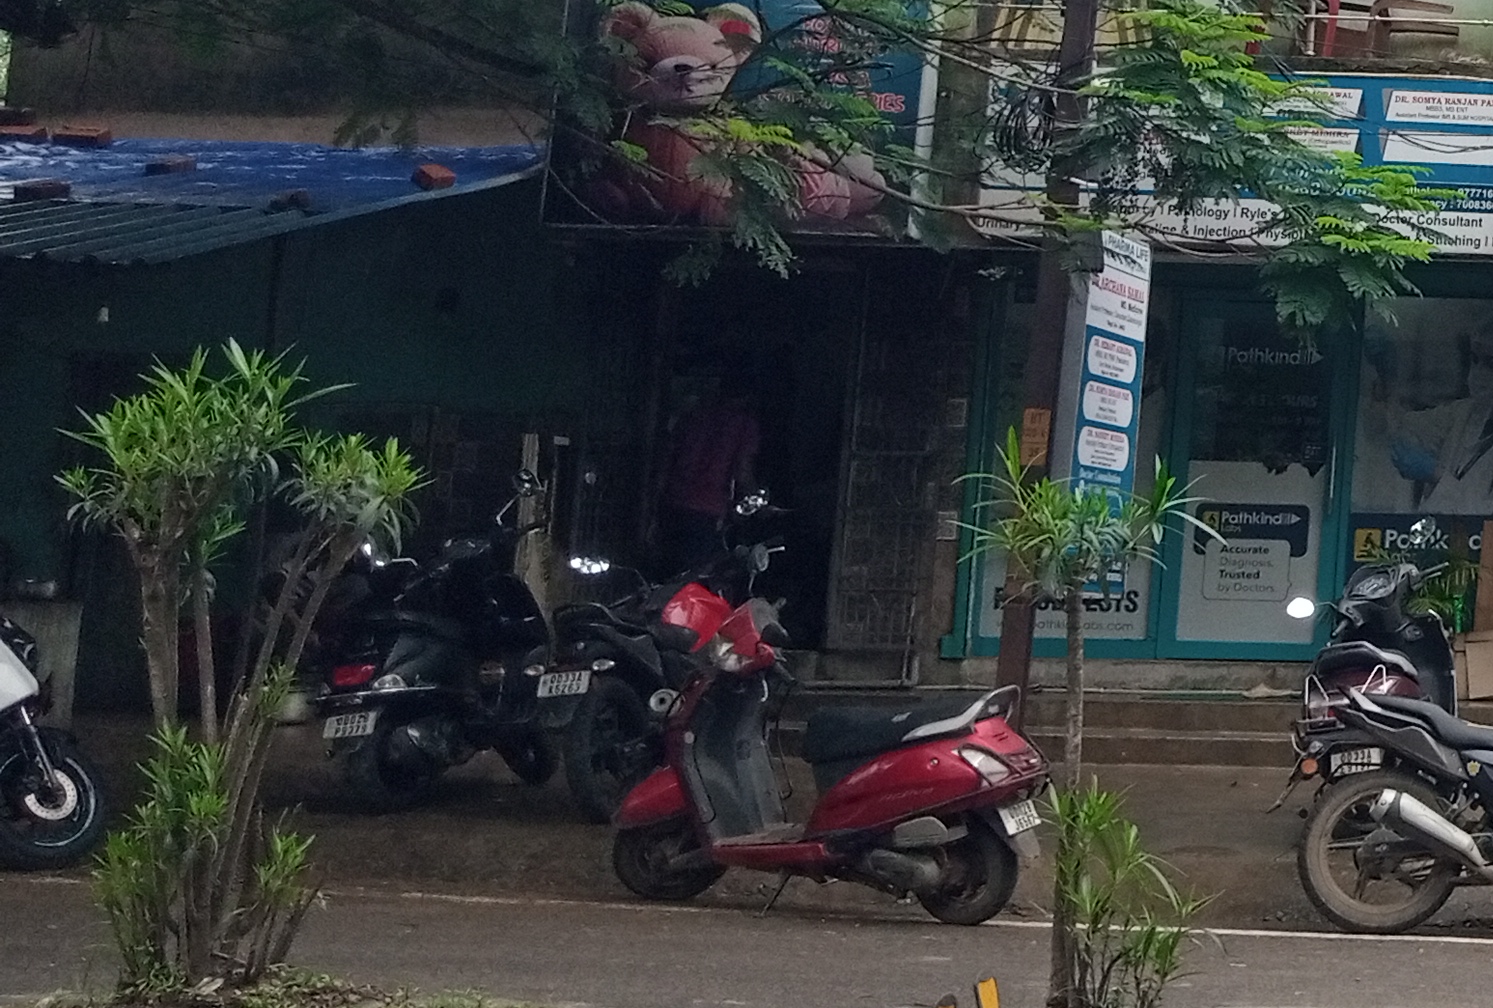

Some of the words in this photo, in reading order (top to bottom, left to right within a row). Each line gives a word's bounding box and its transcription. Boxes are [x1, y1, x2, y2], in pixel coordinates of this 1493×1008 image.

[1417, 215, 1483, 228] Consultant
[1221, 512, 1281, 525] Pathkind
[1221, 546, 1270, 554] Accurate
[1219, 569, 1260, 580] Trusted
[1234, 582, 1274, 593] Doctors
